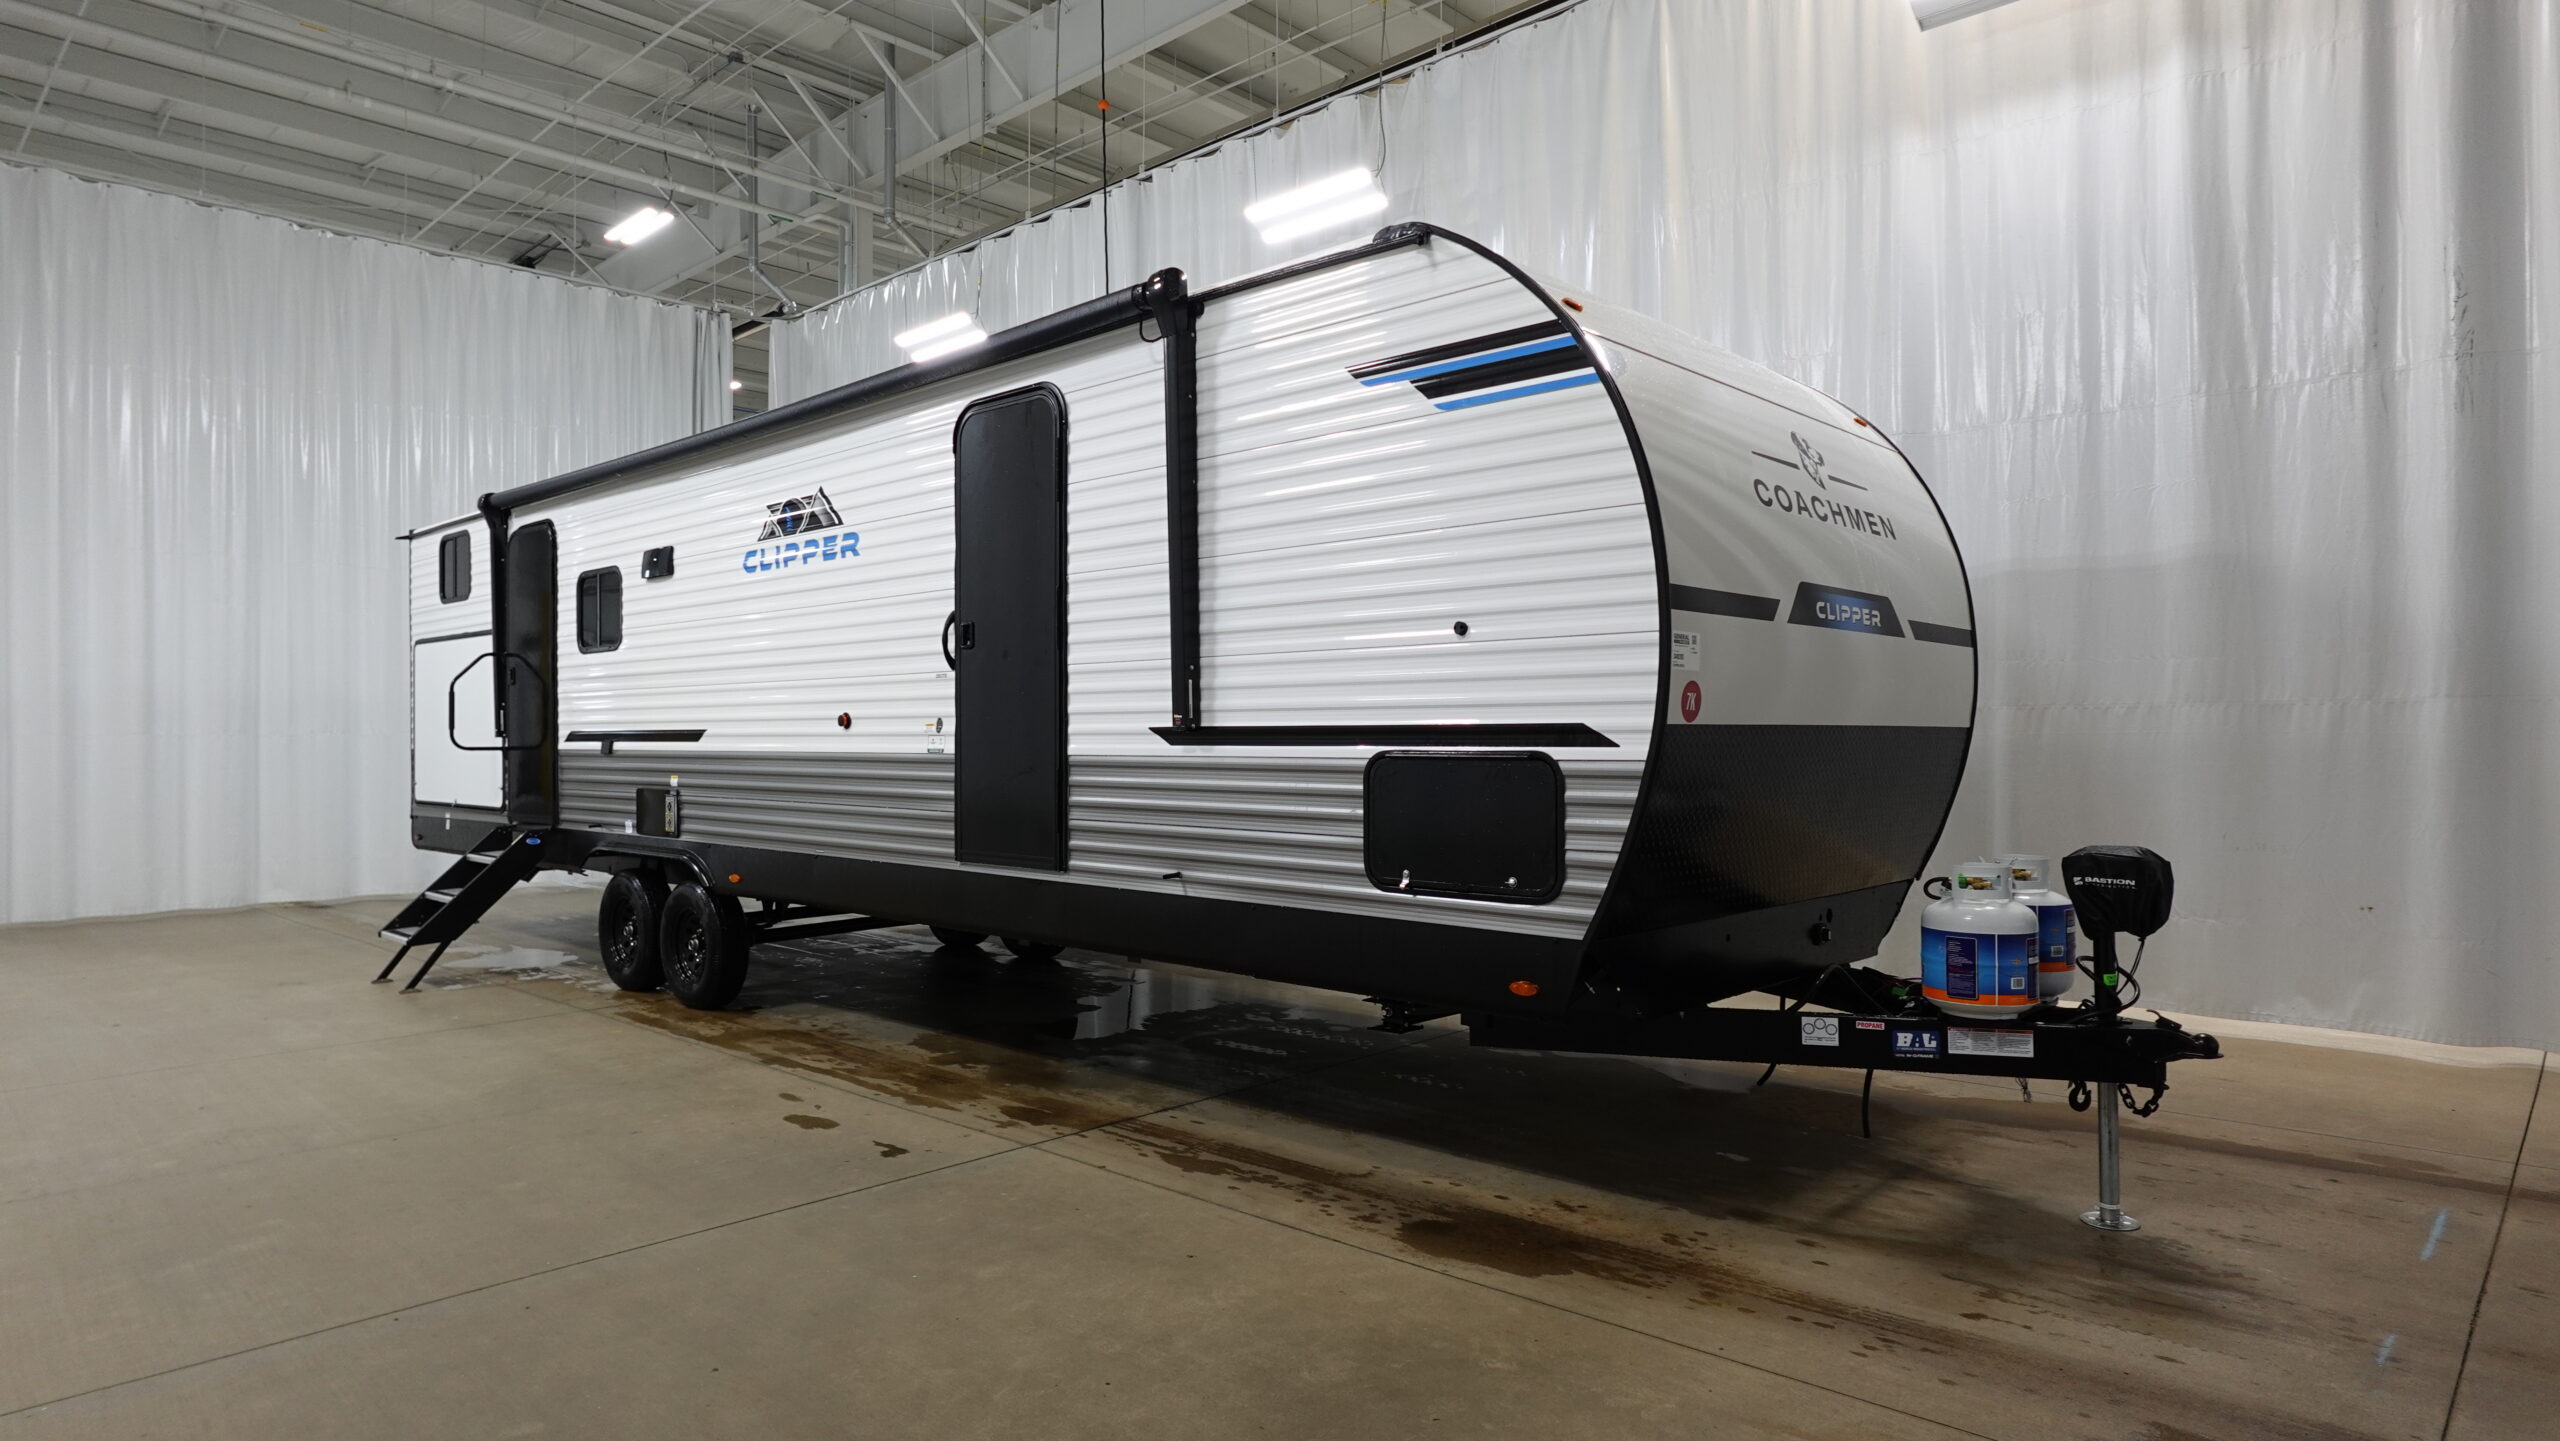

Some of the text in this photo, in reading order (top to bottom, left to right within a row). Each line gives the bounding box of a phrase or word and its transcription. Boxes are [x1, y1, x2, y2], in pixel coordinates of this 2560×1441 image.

[1753, 478, 1897, 540] COACHMEN
[743, 531, 860, 574] CLIPPER
[1815, 601, 1881, 628] CLIPPER
[1686, 692, 1697, 711] 7K
[2084, 876, 2136, 886] BASTION
[1856, 1021, 1884, 1030] PROPANE
[1896, 1032, 1937, 1048] BAL
